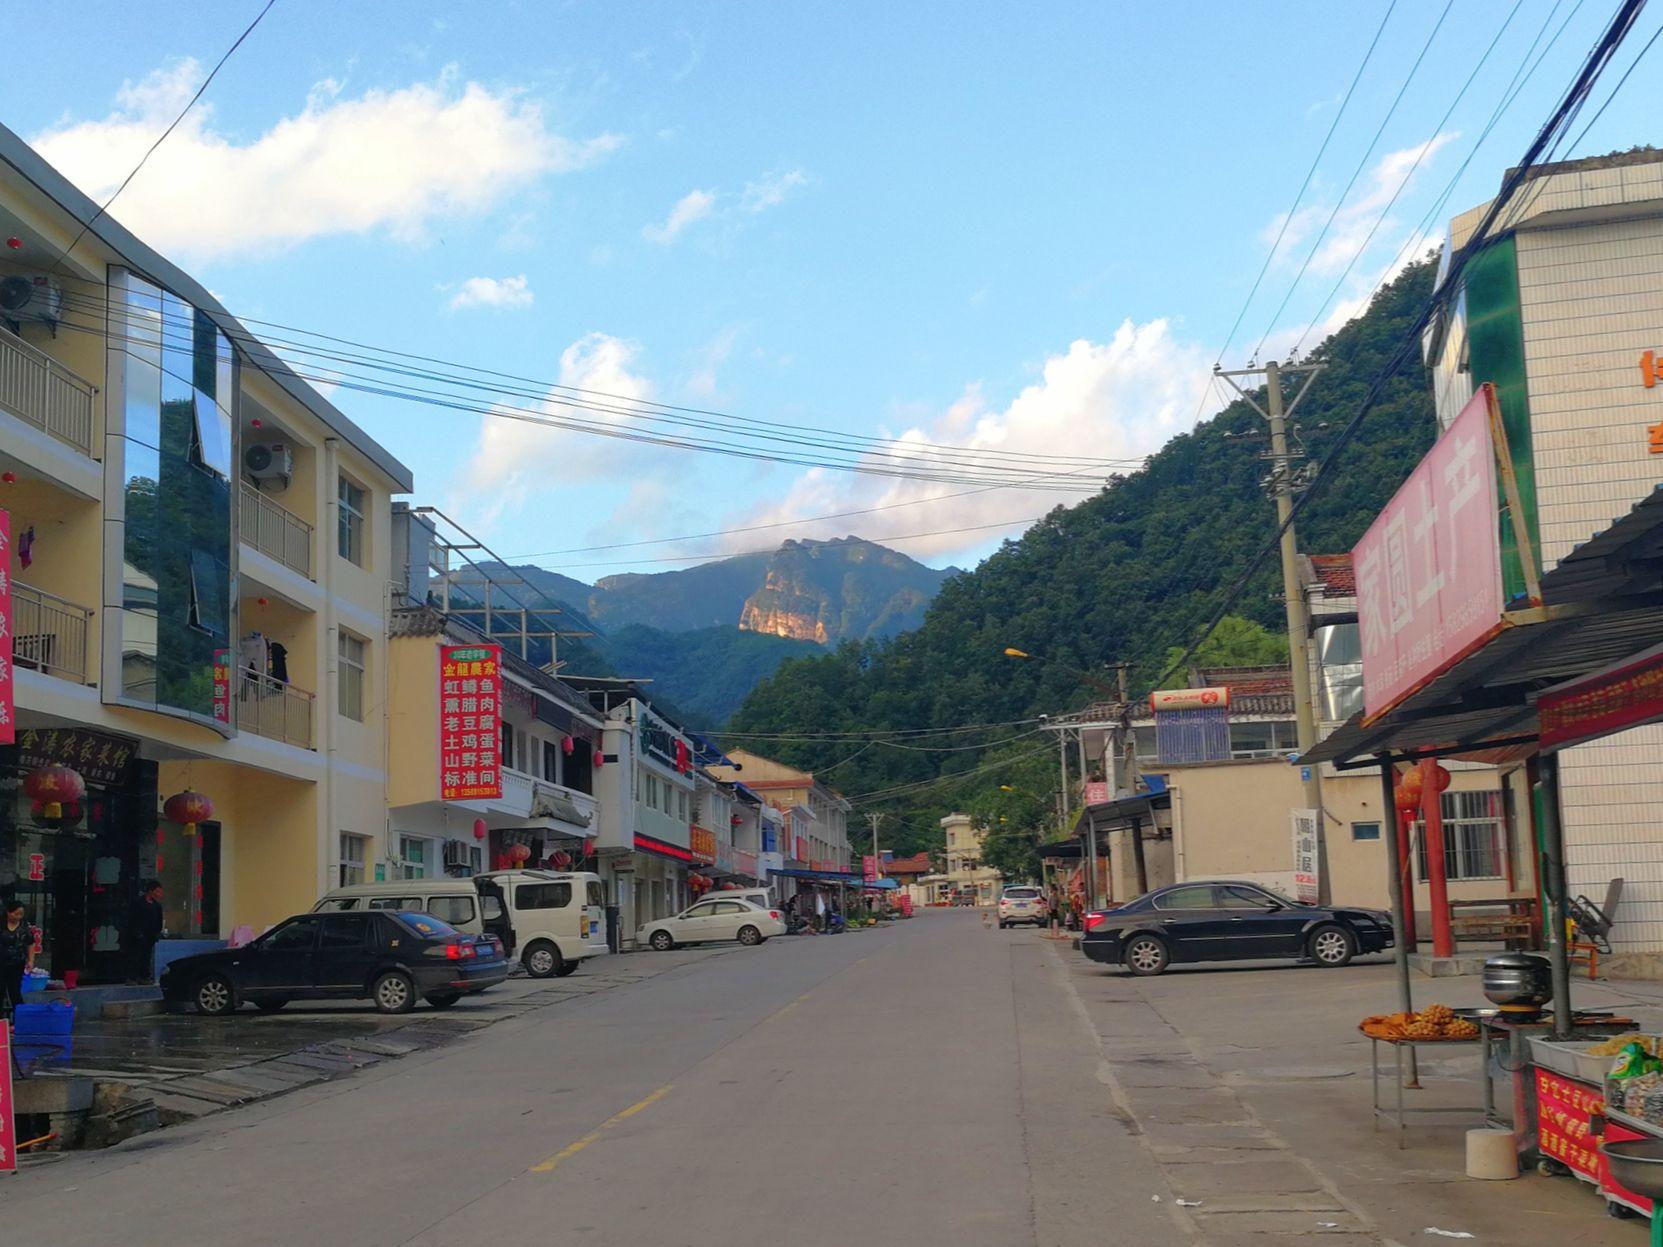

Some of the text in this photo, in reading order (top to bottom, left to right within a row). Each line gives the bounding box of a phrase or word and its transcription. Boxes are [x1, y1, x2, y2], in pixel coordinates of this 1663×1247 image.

[444, 715, 494, 732] 老豆腐
[444, 733, 495, 749] 土鸡蛋
[444, 751, 495, 768] 山野菜
[444, 770, 495, 787] 标准间
